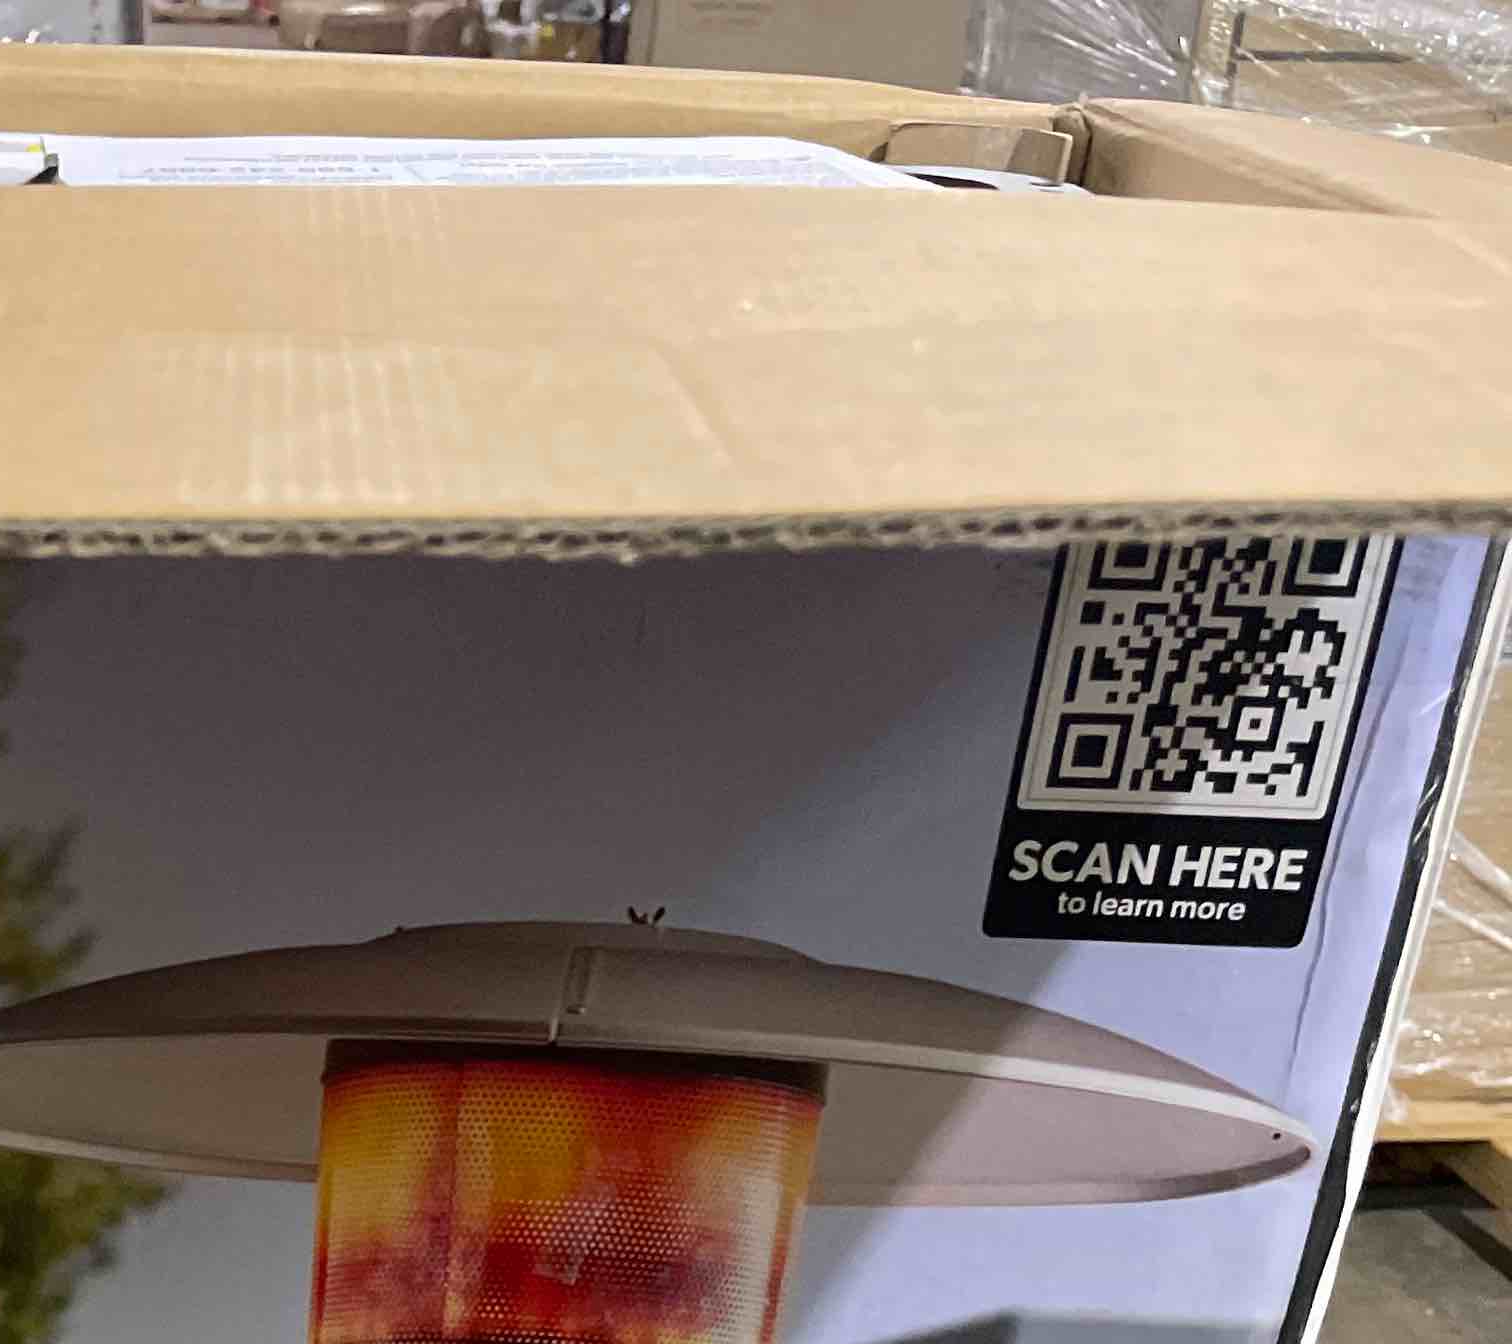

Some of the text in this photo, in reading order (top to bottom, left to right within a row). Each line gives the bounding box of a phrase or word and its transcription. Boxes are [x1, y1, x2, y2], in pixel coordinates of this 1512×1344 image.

[1008, 840, 1308, 891] SCAN HERE
[1057, 892, 1245, 921] to learn more
